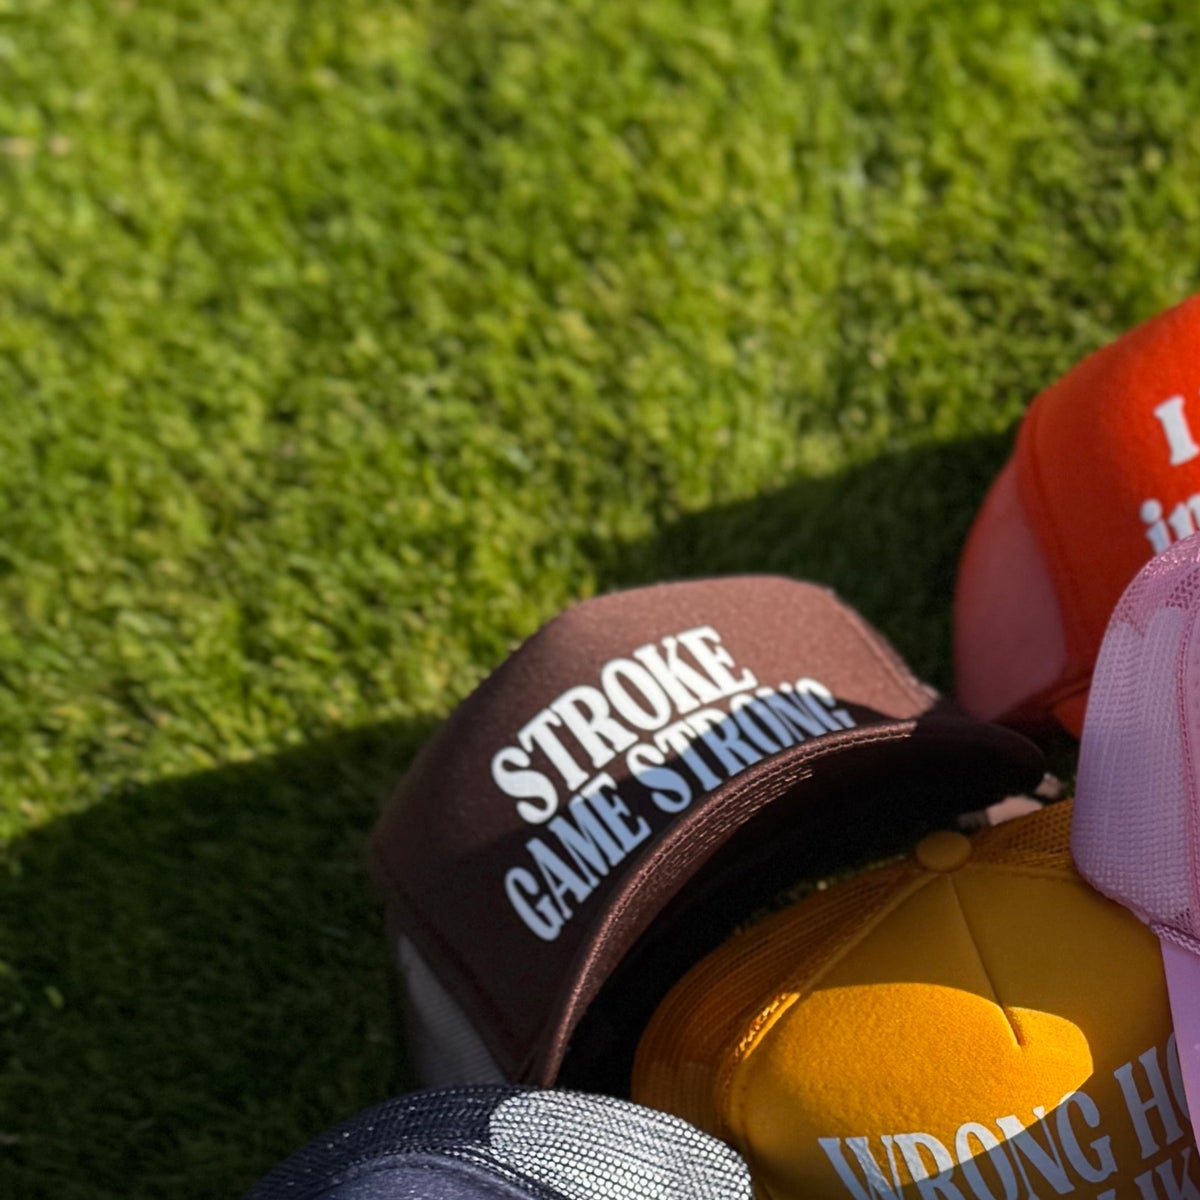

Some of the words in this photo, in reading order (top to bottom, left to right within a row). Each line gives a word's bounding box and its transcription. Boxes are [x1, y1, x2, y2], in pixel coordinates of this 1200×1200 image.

[490, 625, 758, 825] STROKE
[503, 776, 652, 941] GAME
[625, 677, 857, 813] STRONG
